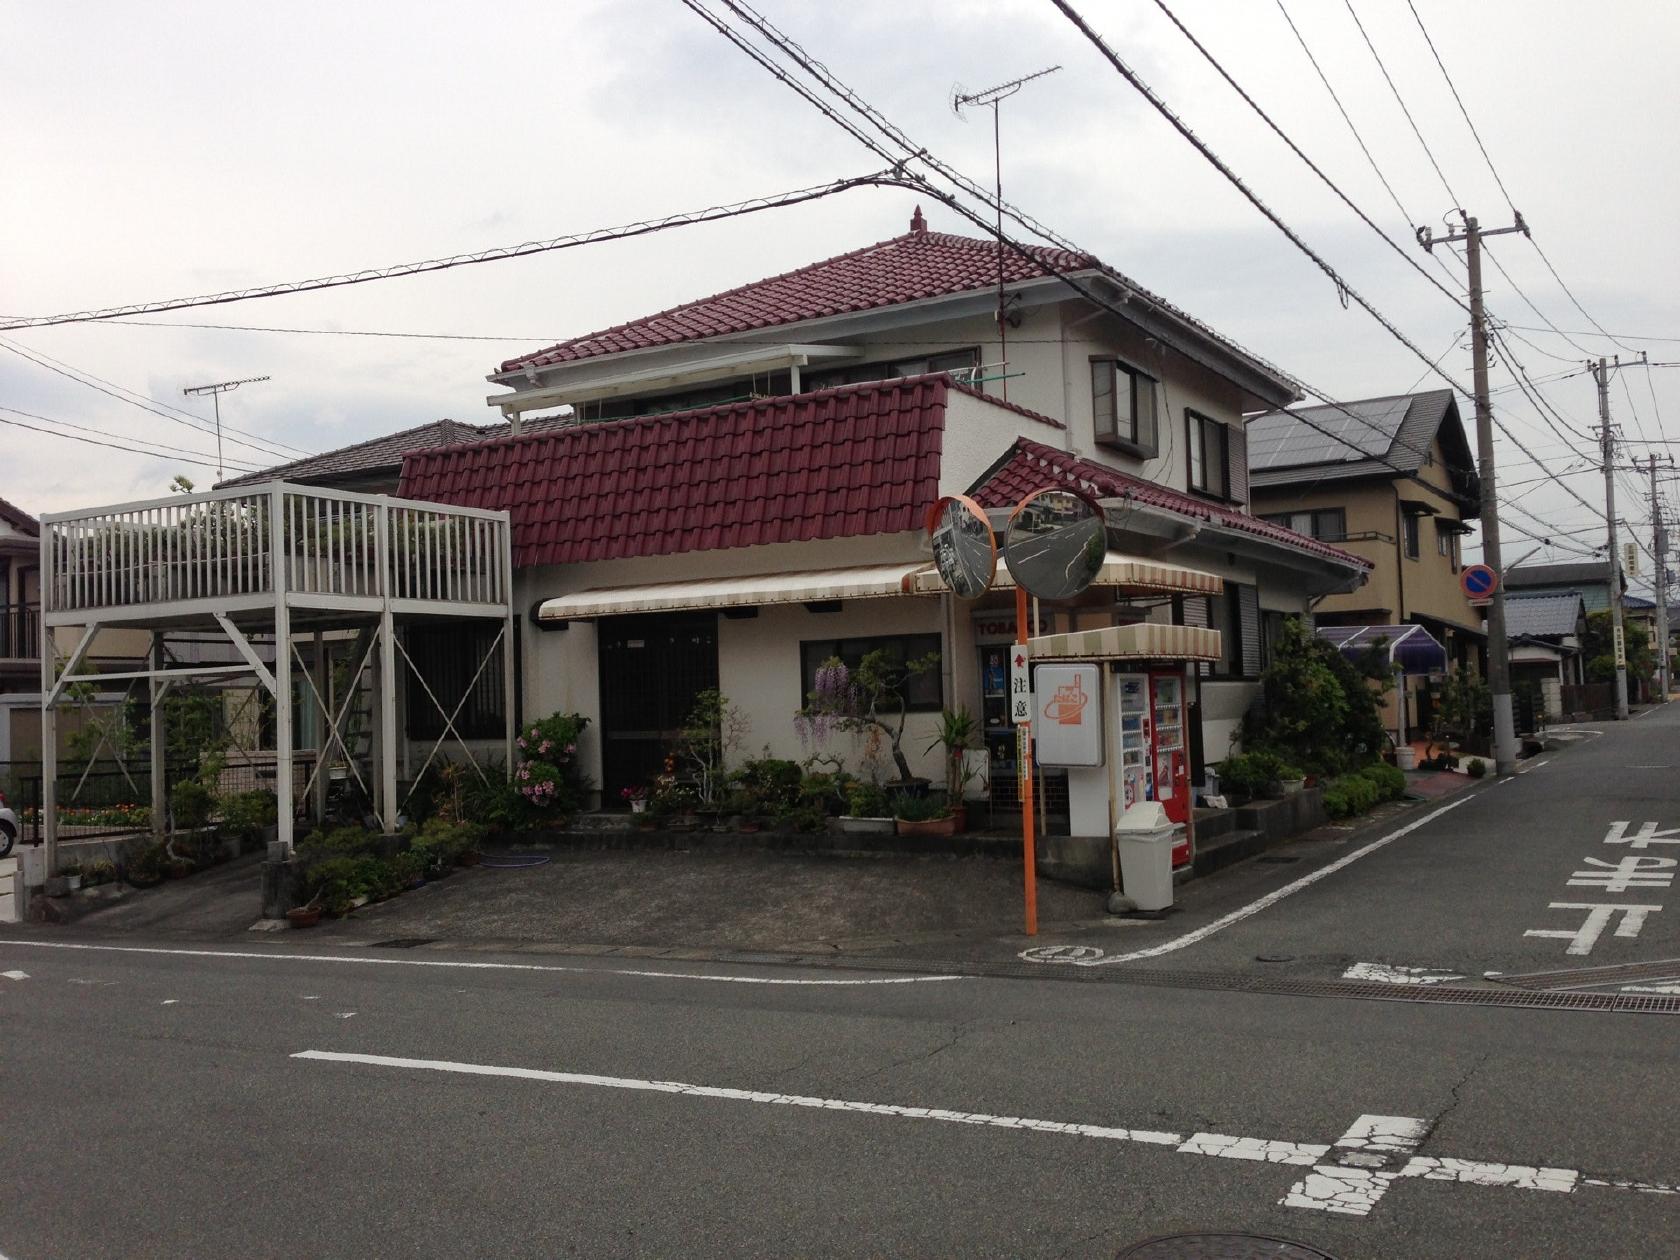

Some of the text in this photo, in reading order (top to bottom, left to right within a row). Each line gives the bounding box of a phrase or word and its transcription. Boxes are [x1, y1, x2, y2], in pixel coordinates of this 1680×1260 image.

[977, 619, 1048, 635] TOBACO
[1013, 676, 1028, 717] 注意
[1522, 820, 1680, 956] 止まれ
